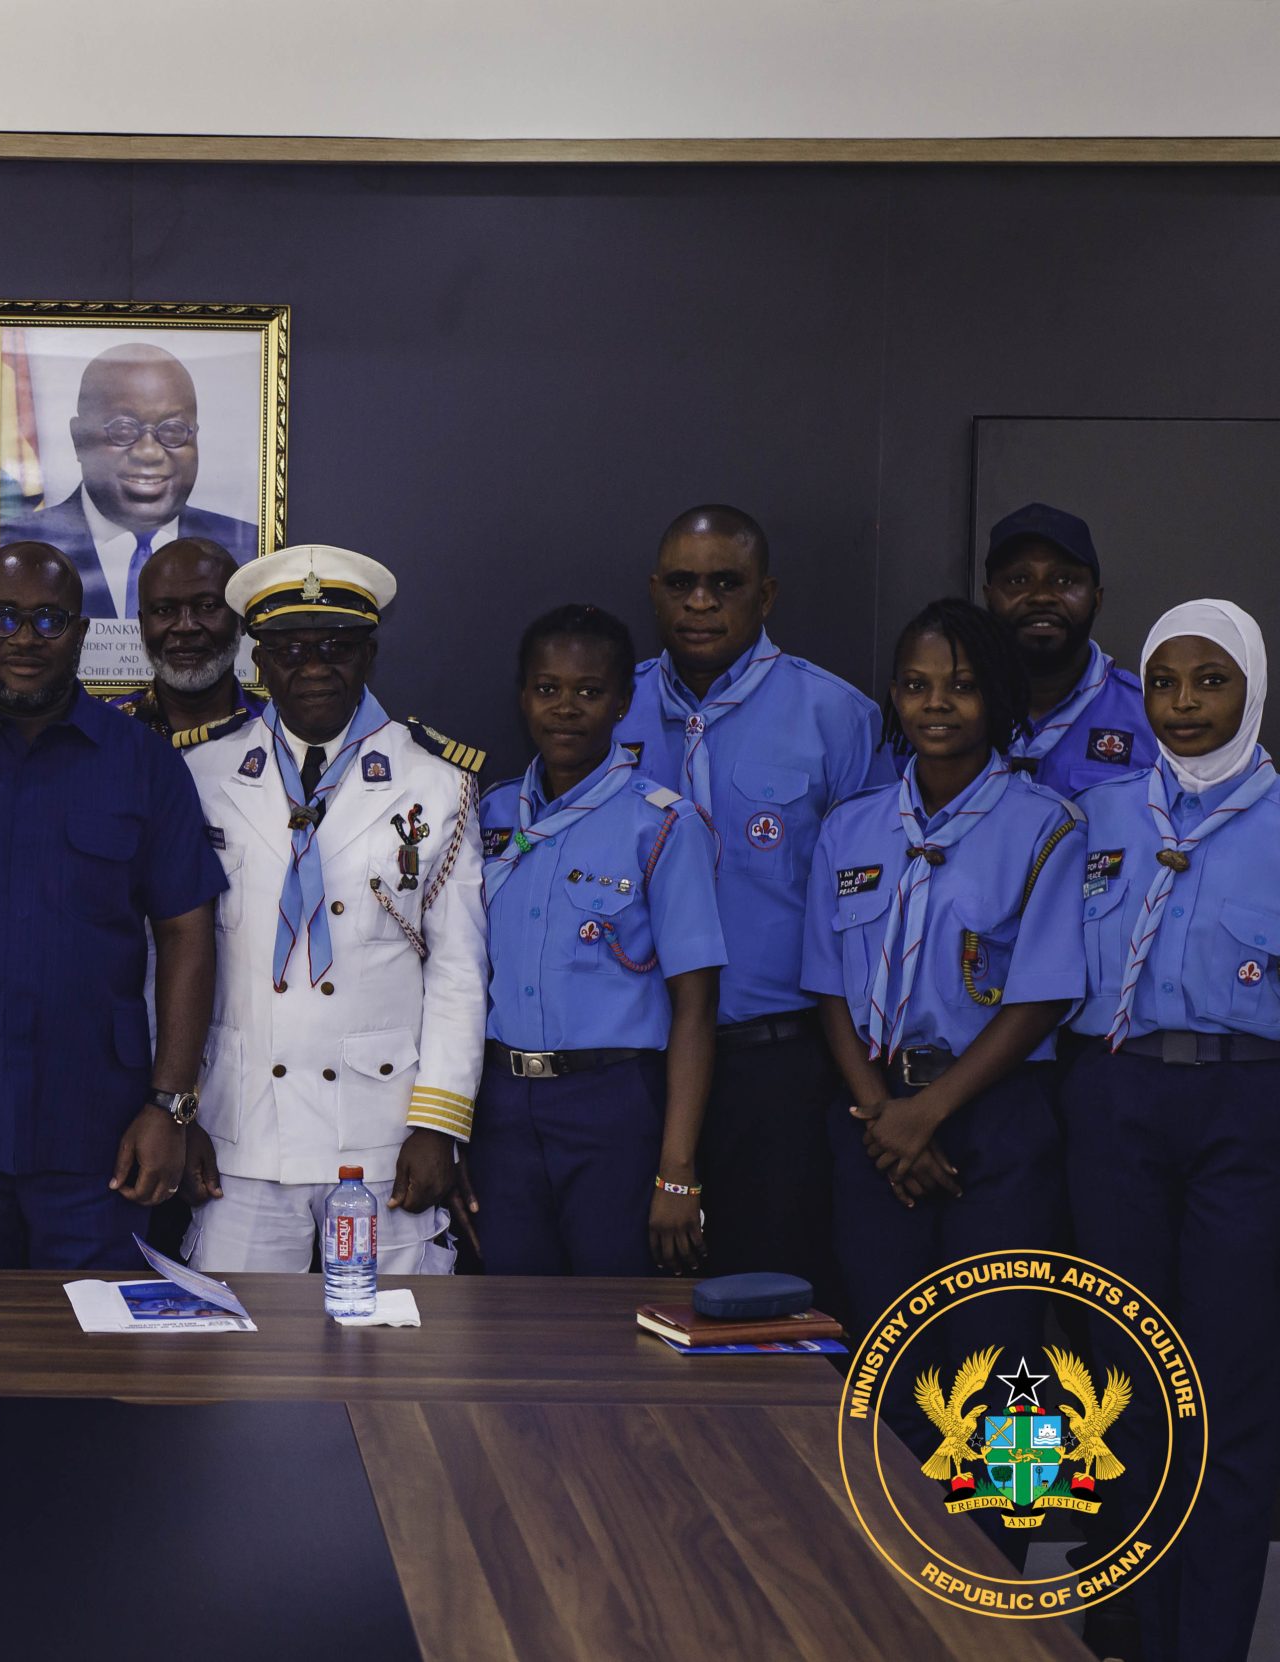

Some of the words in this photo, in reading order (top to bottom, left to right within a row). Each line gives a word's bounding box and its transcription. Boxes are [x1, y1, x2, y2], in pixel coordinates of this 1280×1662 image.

[95, 622, 140, 635] DANKW
[115, 642, 127, 651] OF
[119, 655, 139, 663] AND
[112, 667, 123, 676] OF
[127, 667, 144, 676] THE
[840, 879, 853, 888] FOR
[838, 886, 858, 896] PEACE
[339, 1218, 350, 1257] BEL-AQUA
